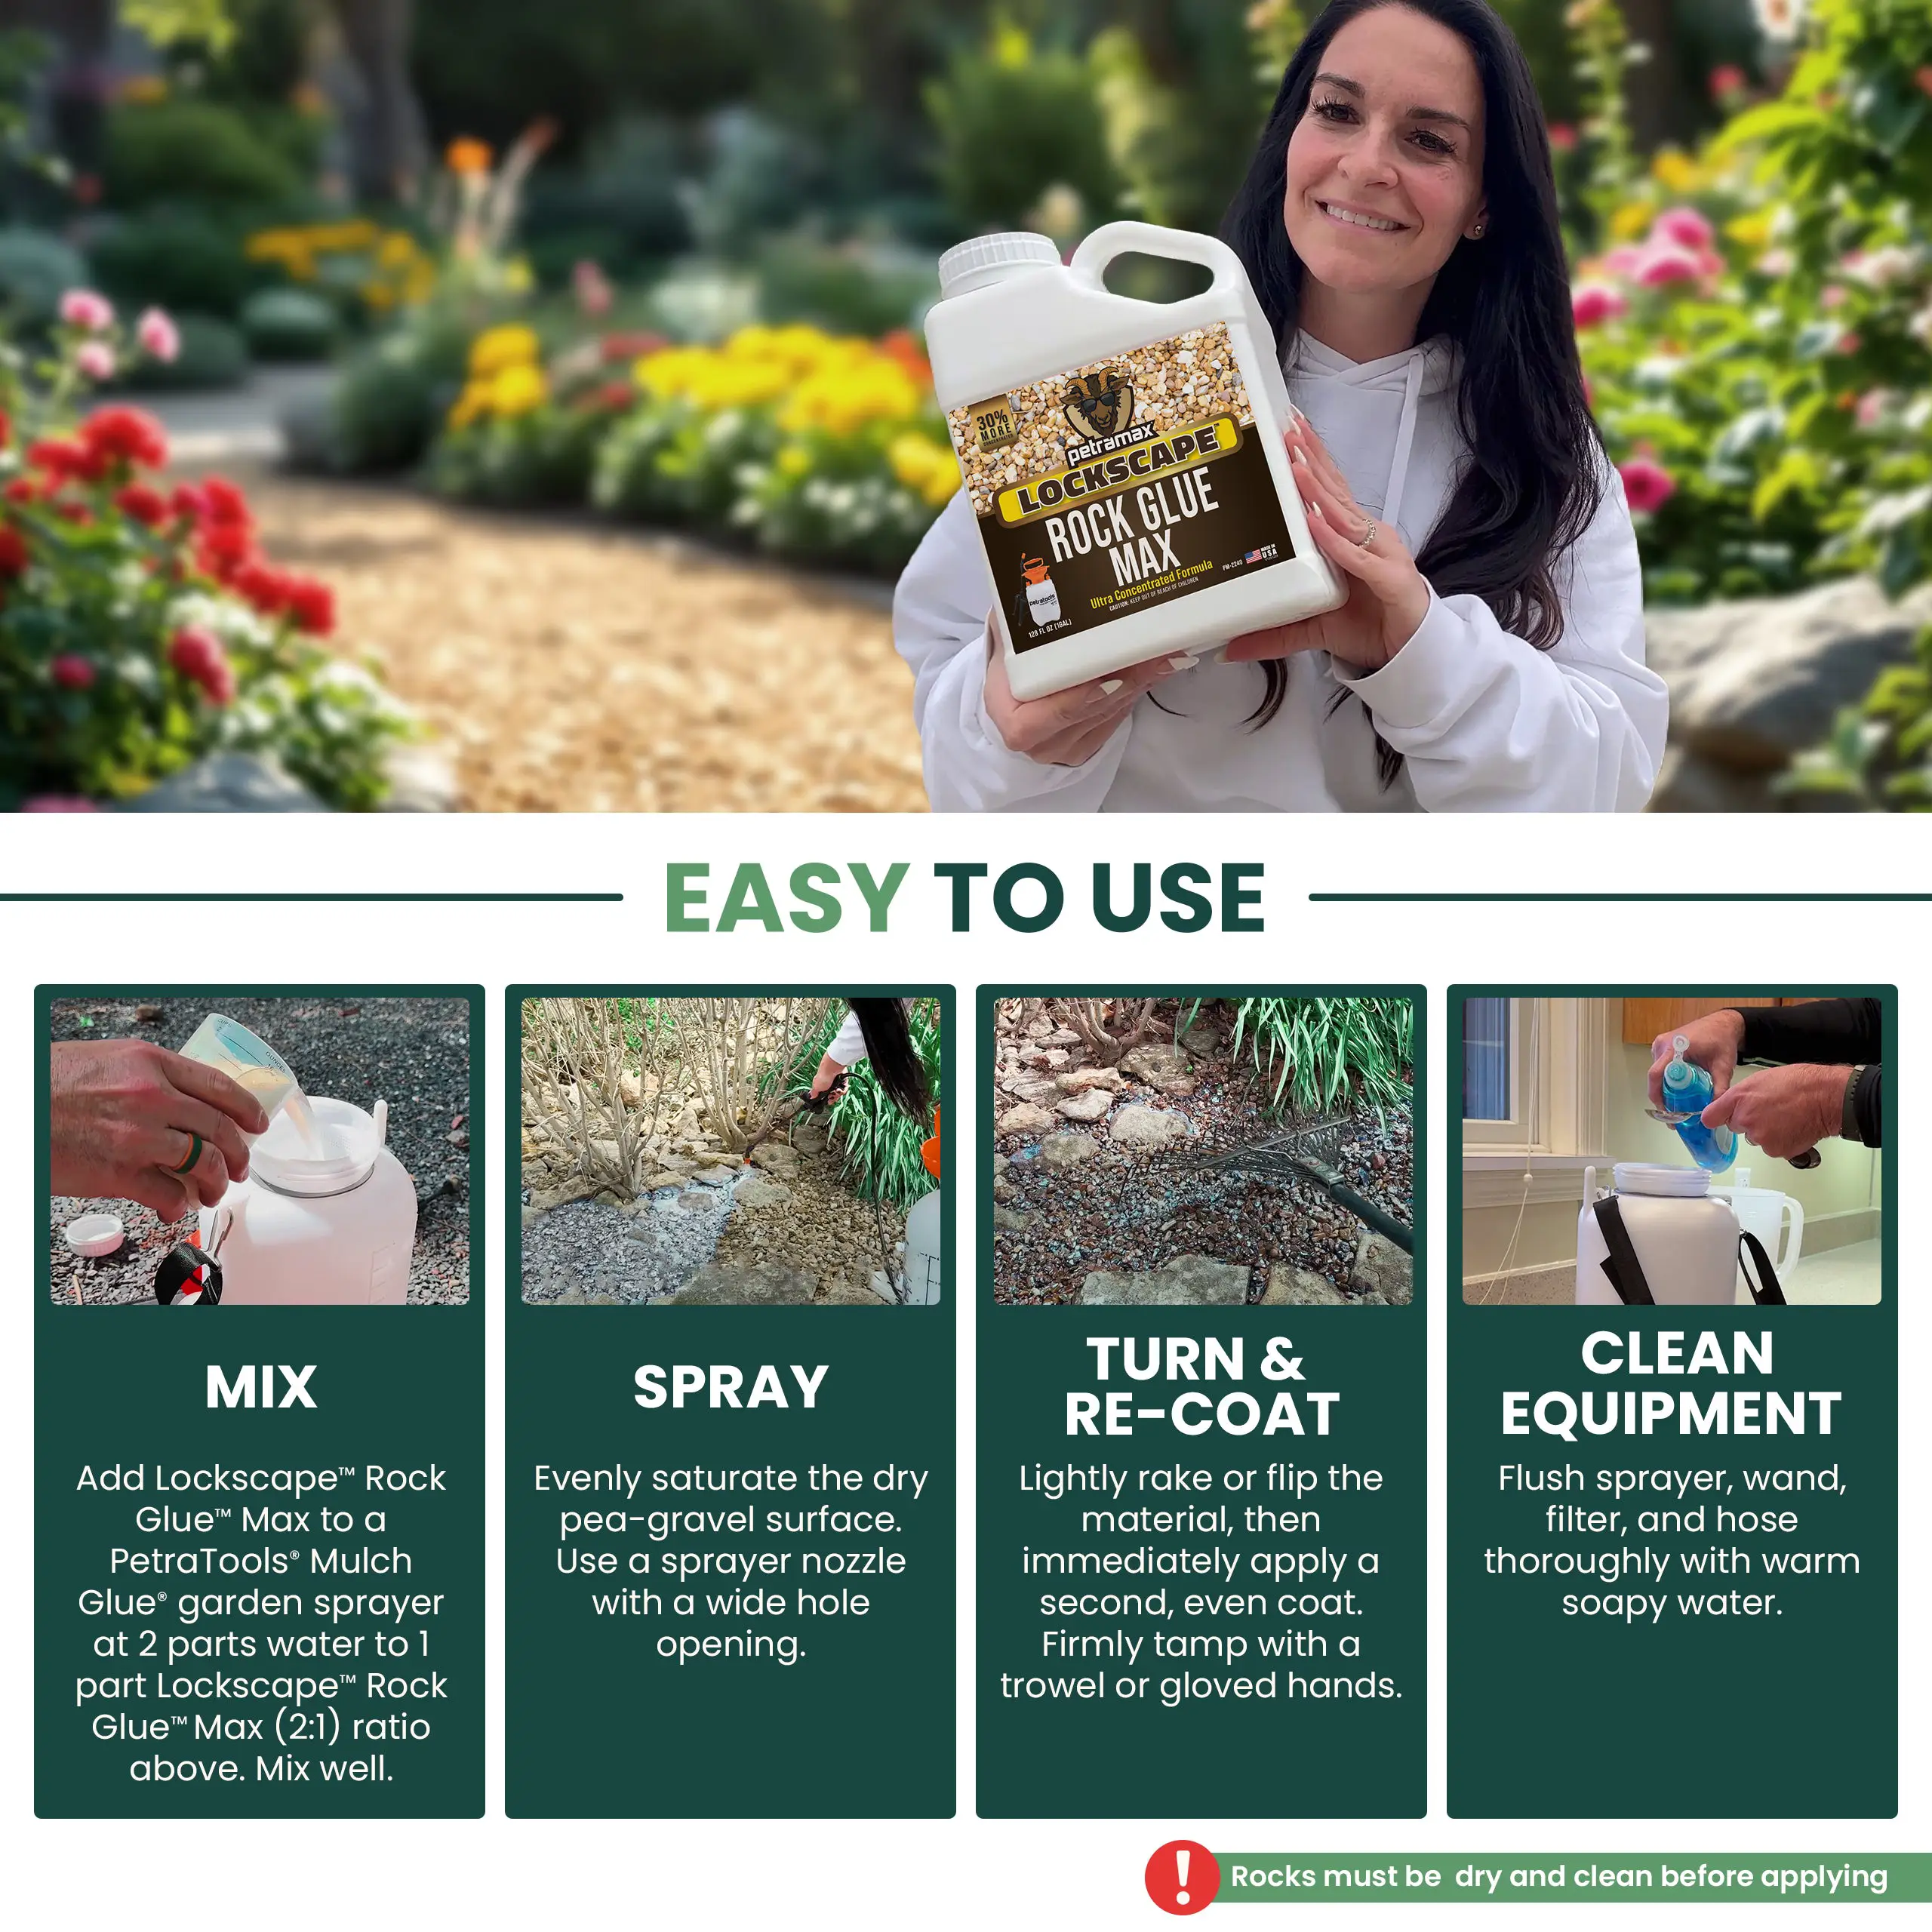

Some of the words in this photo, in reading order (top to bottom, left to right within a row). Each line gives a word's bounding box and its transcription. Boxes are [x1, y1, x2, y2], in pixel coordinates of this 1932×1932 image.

[977, 409, 1008, 430] 30%
[980, 423, 1011, 441] MORE
[1068, 423, 1154, 466] petramax
[1045, 494, 1134, 563] ROCK
[1137, 466, 1220, 531] GLUE
[1109, 528, 1181, 587] MAX
[1223, 559, 1243, 571] PM-2240
[1262, 548, 1278, 558] USA
[1090, 594, 1114, 609] Ultra
[1114, 571, 1176, 601] Concentrated
[1177, 559, 1214, 580] Formula
[1109, 601, 1130, 612] CAUTION:
[1130, 595, 1141, 605] KEEP
[1156, 586, 1171, 595] REACH
[1177, 576, 1199, 588] CHILDREN
[1029, 630, 1038, 638] 128
